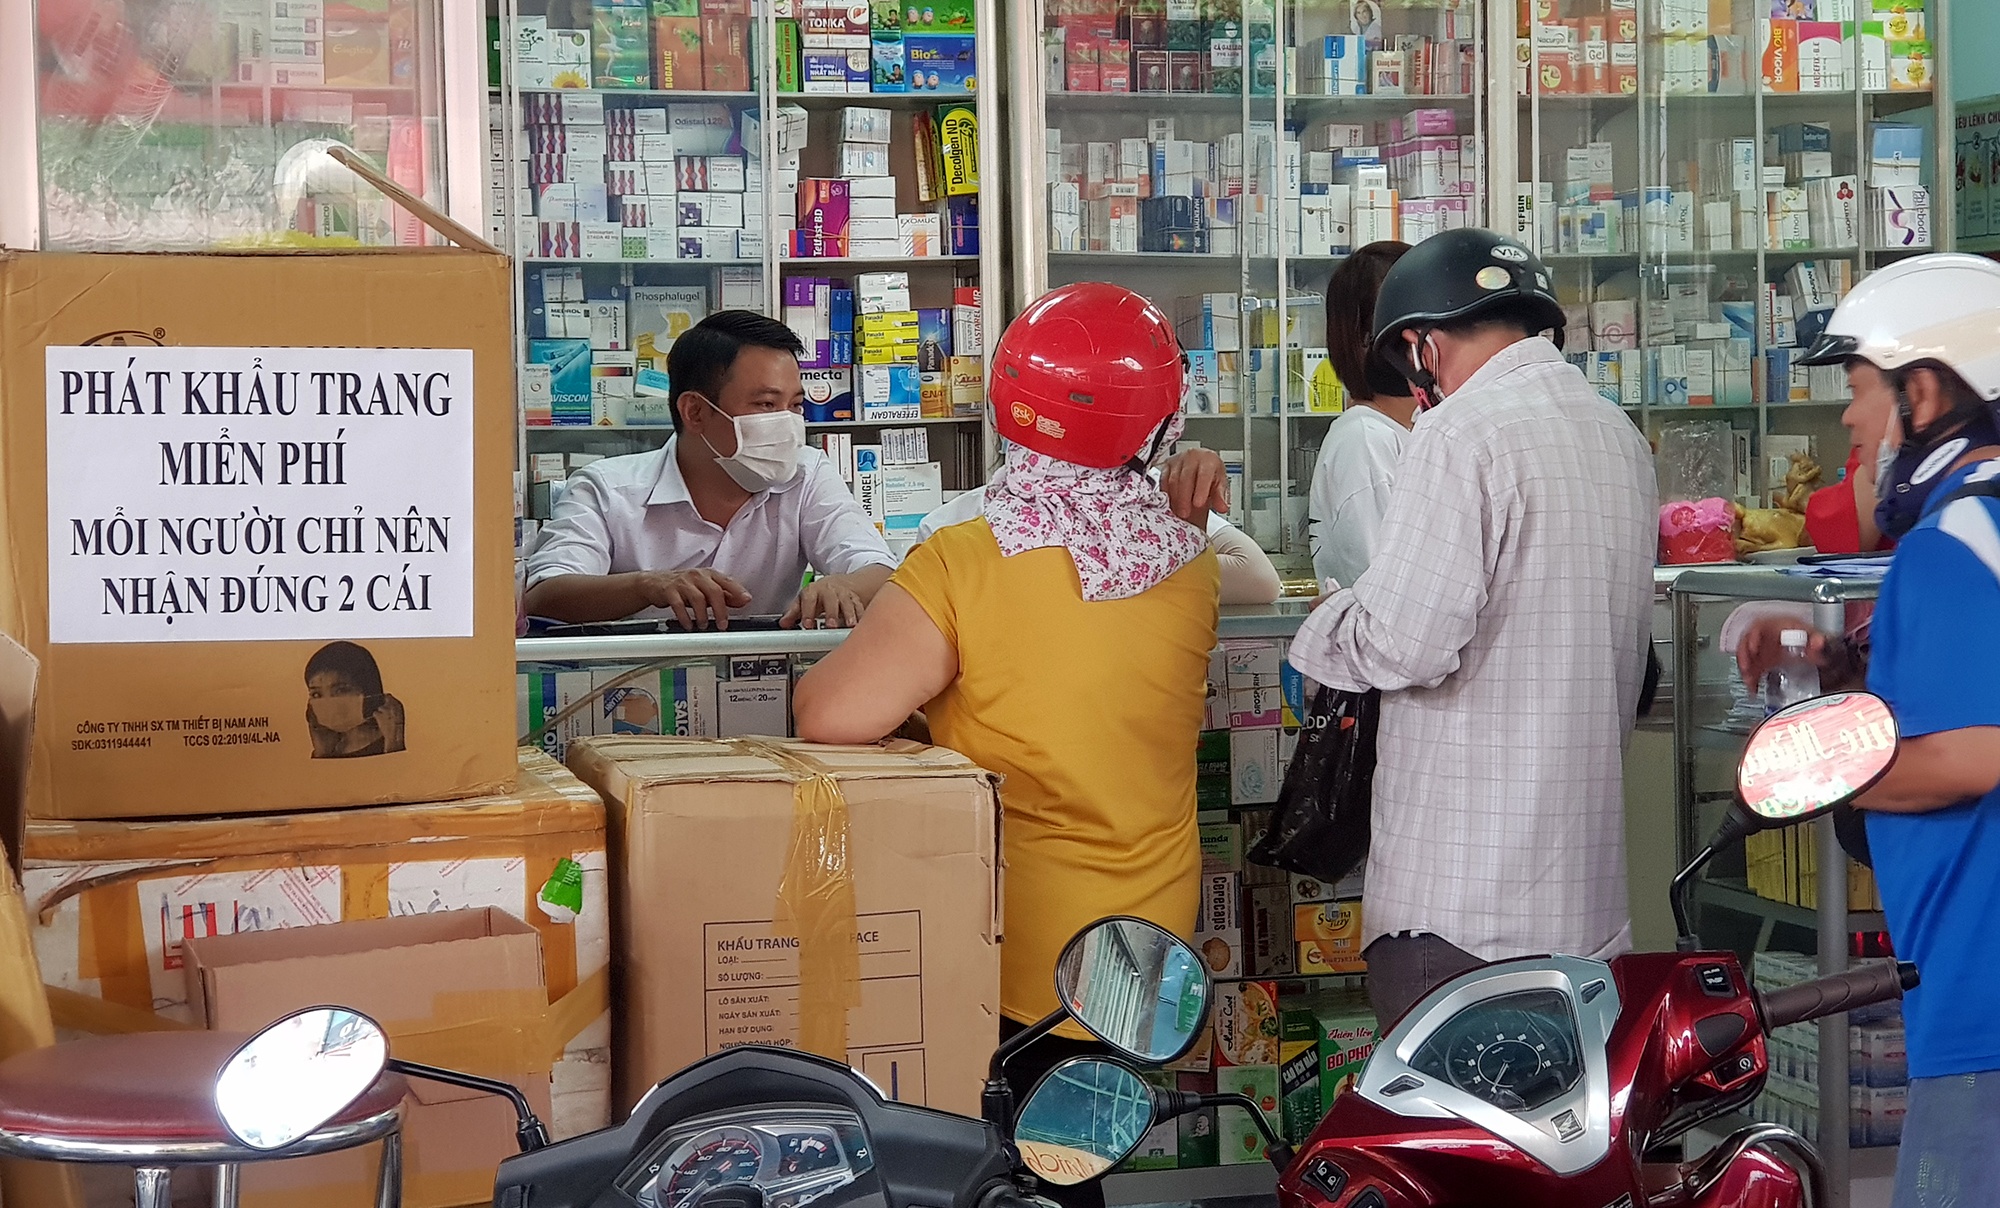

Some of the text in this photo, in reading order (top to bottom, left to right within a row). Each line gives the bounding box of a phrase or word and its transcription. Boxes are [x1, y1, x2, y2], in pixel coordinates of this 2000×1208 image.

[808, 17, 846, 28] TONKA
[664, 50, 673, 89] BOGANIC
[948, 119, 963, 186] Decolgen ND
[900, 216, 937, 226] EXOMUC
[1917, 190, 1926, 243] Phlebodia
[814, 208, 825, 257] Telfast BD
[634, 292, 700, 302] Phosphalugel
[972, 289, 982, 348] VASTAREL MR
[60, 357, 453, 417] PHÁT KHẨU TRANG
[551, 393, 589, 403] VISCON
[870, 408, 919, 420] EFFERALGAN
[1013, 406, 1031, 422] gsk
[159, 428, 348, 486] MIỂN PHÍ
[70, 505, 451, 556] MỔI NGƯỜI CHỈ NÊN
[101, 564, 432, 626] NHẬN ĐÚNG 2 CÁI
[765, 666, 782, 675] KY
[729, 694, 738, 702] 12
[758, 694, 768, 702] 20
[77, 715, 269, 734] CÔNG TY TNHH SX TM THIẾT BỊ NAM ANH
[674, 700, 689, 737] SALO
[183, 731, 280, 747] TCCS 02:2019/4L-NA
[1212, 876, 1227, 931] Cerecaps
[756, 936, 800, 949] TRANG
[718, 971, 729, 982] SỐ
[1282, 1066, 1296, 1084] CAO
[1293, 1059, 1306, 1076] ÍCH
